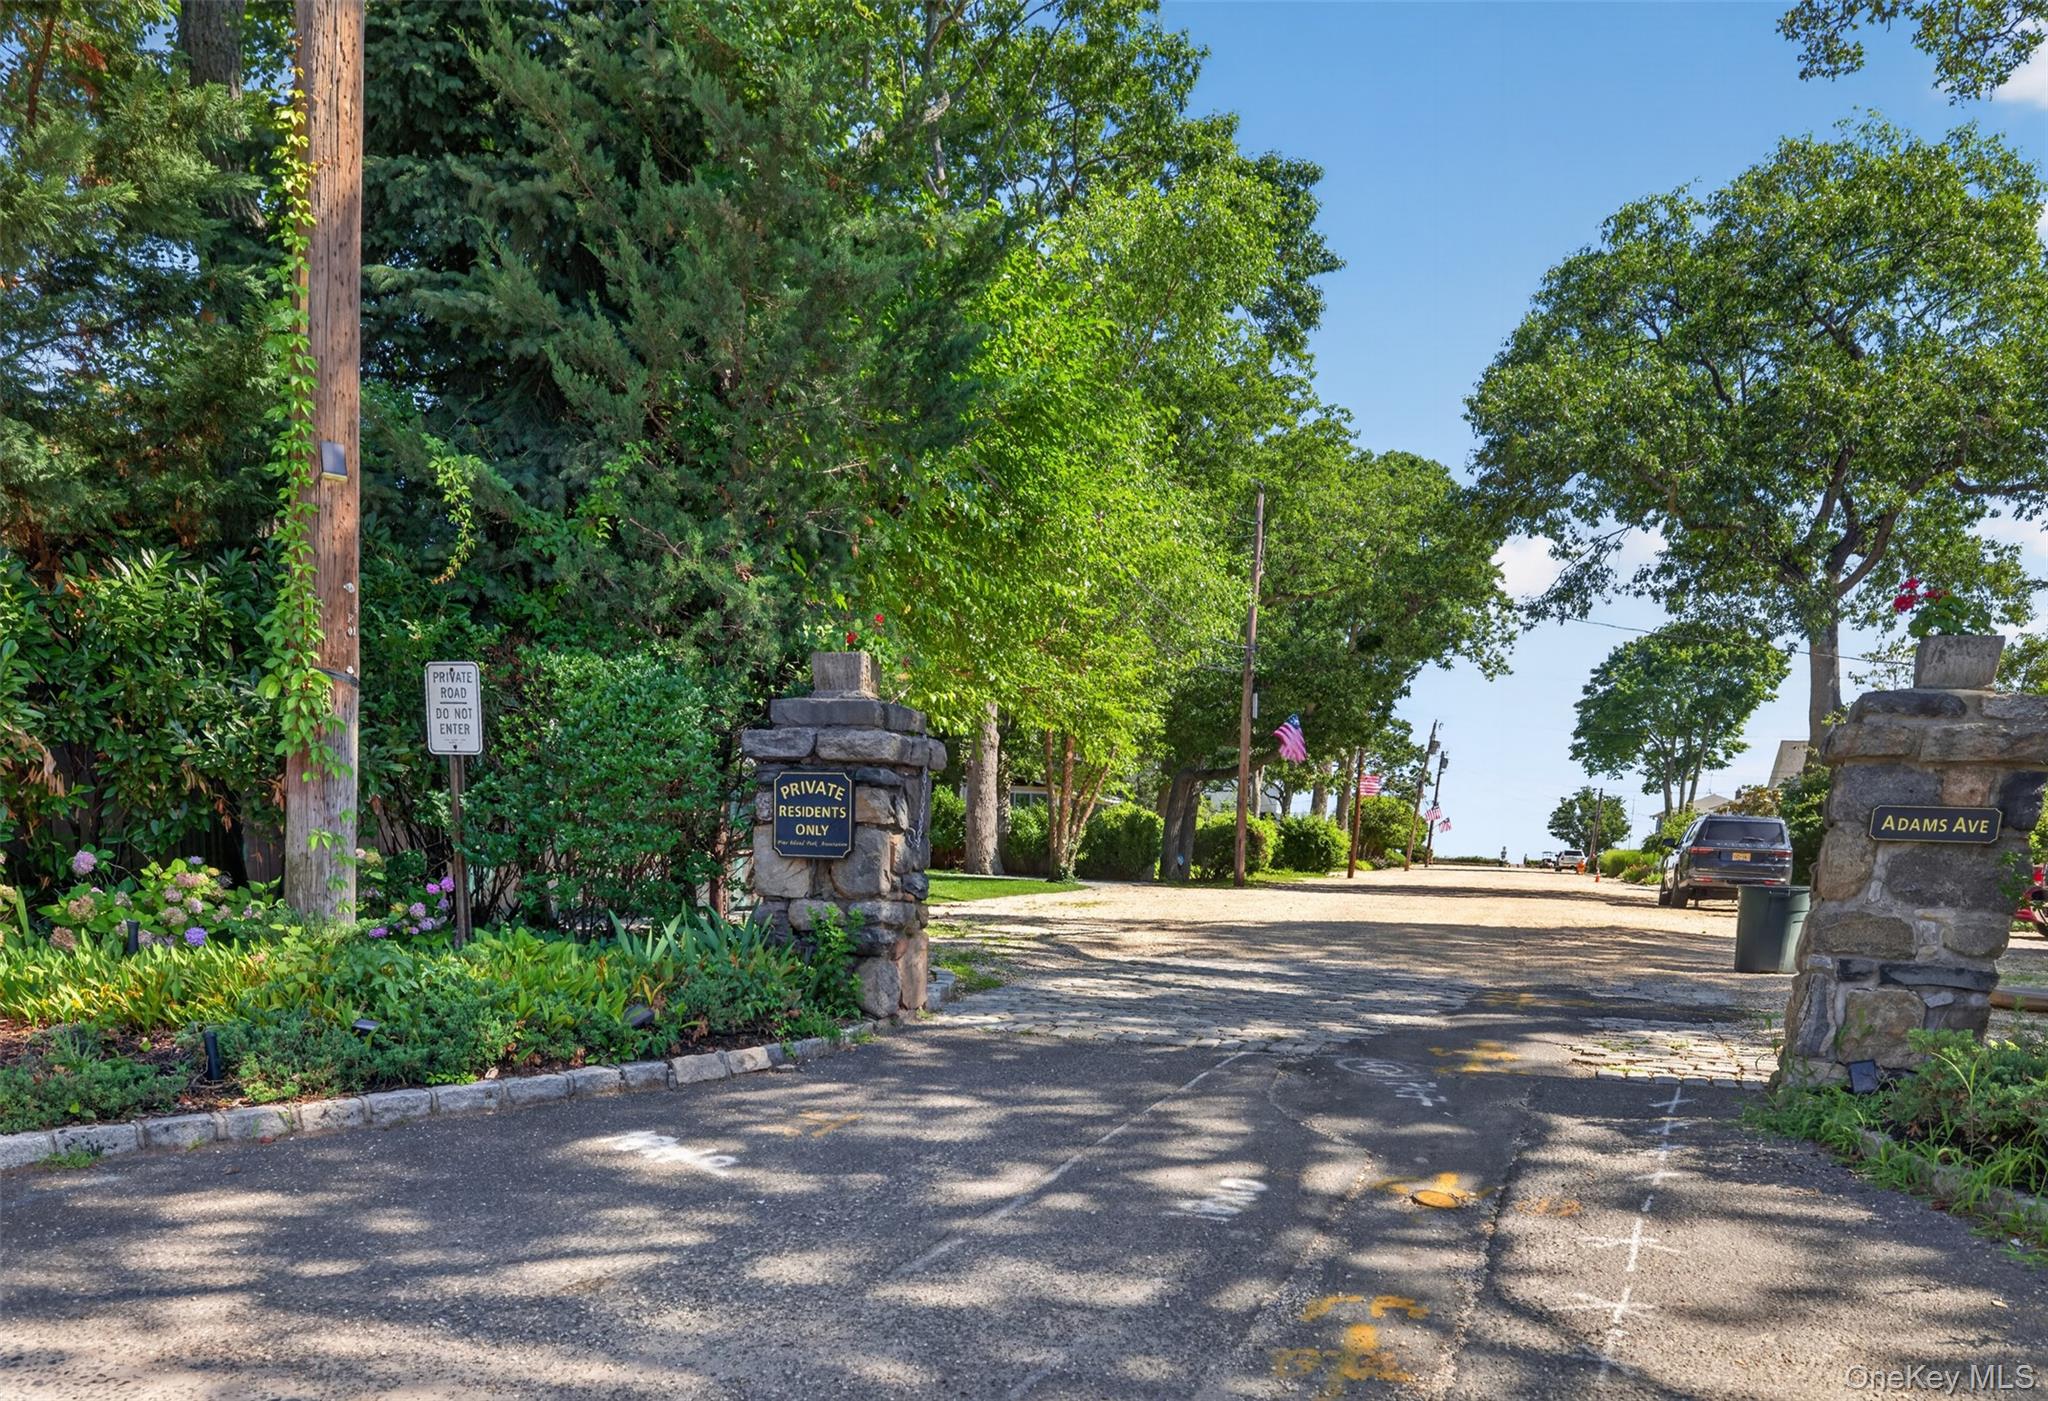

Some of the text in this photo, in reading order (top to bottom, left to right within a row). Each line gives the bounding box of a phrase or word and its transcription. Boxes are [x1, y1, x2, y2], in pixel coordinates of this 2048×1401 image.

[433, 672, 472, 683] PRIVATE
[440, 687, 467, 698] ROAD
[436, 708, 472, 719] DO NOT
[440, 724, 470, 735] ENTER
[780, 780, 845, 801] PRIVATE
[779, 805, 846, 818] RESIDENTS
[795, 823, 829, 836] ONLY
[1881, 815, 1990, 833] ADAMS AVE
